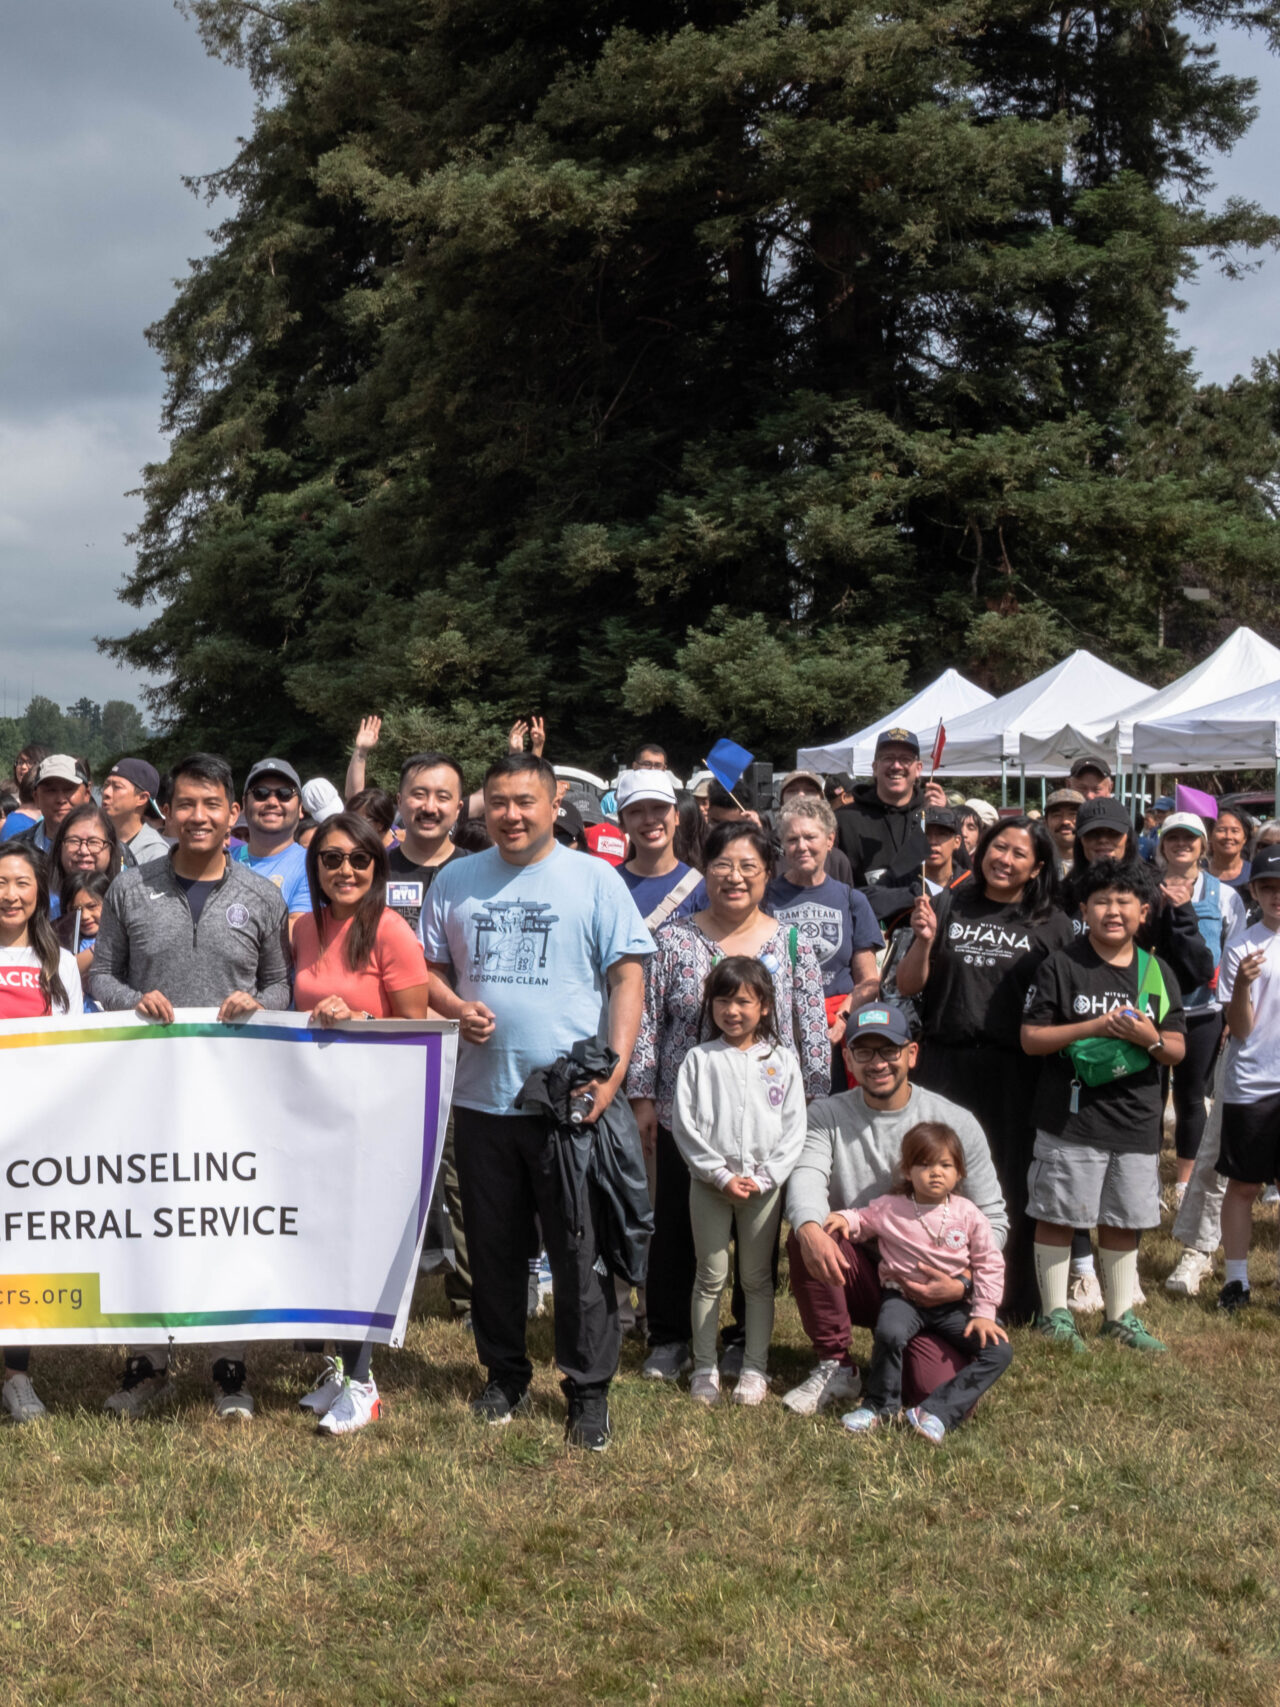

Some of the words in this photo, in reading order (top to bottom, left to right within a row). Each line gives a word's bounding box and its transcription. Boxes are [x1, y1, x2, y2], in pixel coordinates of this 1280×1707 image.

[391, 888, 417, 901] RYU
[779, 909, 809, 920] SAM'S
[811, 909, 836, 919] TEAM
[948, 922, 1032, 952] OHANA
[481, 975, 514, 984] SPRING
[515, 976, 549, 986] CLEAN
[6, 1151, 256, 1189] COUNSELING
[153, 1205, 299, 1239] SERVICE
